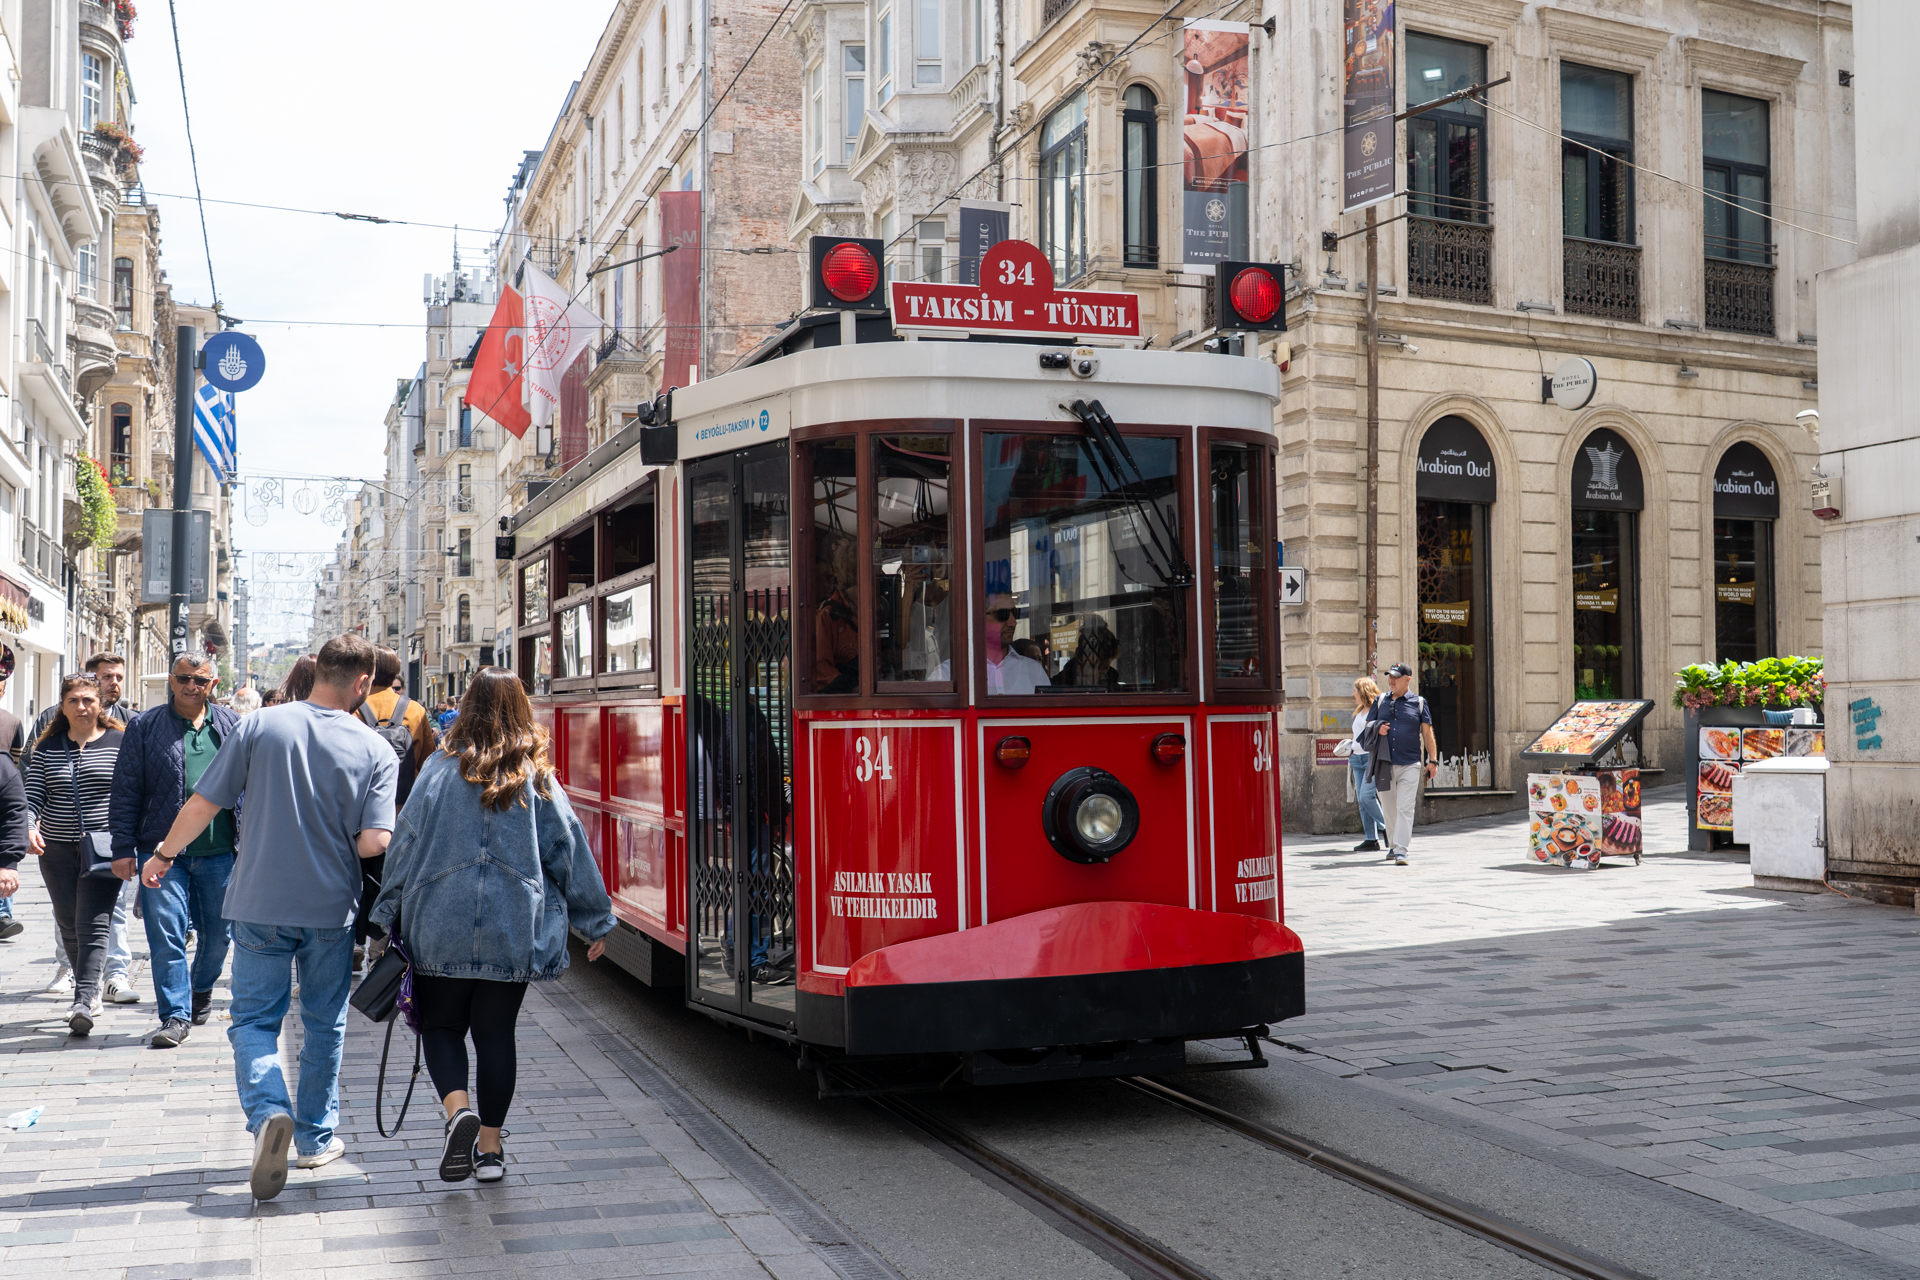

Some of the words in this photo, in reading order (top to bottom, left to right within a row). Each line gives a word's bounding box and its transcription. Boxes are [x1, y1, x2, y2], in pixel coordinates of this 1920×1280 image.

[1363, 157, 1393, 174] PUBLIC
[999, 260, 1035, 286] 34
[905, 292, 1014, 322] TAKSİM
[1044, 297, 1132, 328] TÜNEL
[670, 341, 697, 350] MÜZES
[530, 382, 557, 404] TURİZM
[701, 418, 750, 440] BEYOĞLU-TAKSİM
[760, 415, 768, 426] T2
[1416, 457, 1462, 475] Arabian
[1467, 461, 1490, 478] Oud
[1586, 490, 1609, 500] Arabian
[1610, 492, 1622, 500] Oud
[1754, 480, 1774, 496] Oud
[856, 736, 892, 782] 34
[1254, 729, 1272, 772] 34
[1238, 856, 1270, 878] ASILMAK
[834, 871, 884, 893] ASILMAK
[887, 872, 932, 894] YASAK
[1235, 883, 1248, 903] VE
[830, 896, 844, 917] VE
[845, 896, 938, 919] TEHLIKELIDIR
